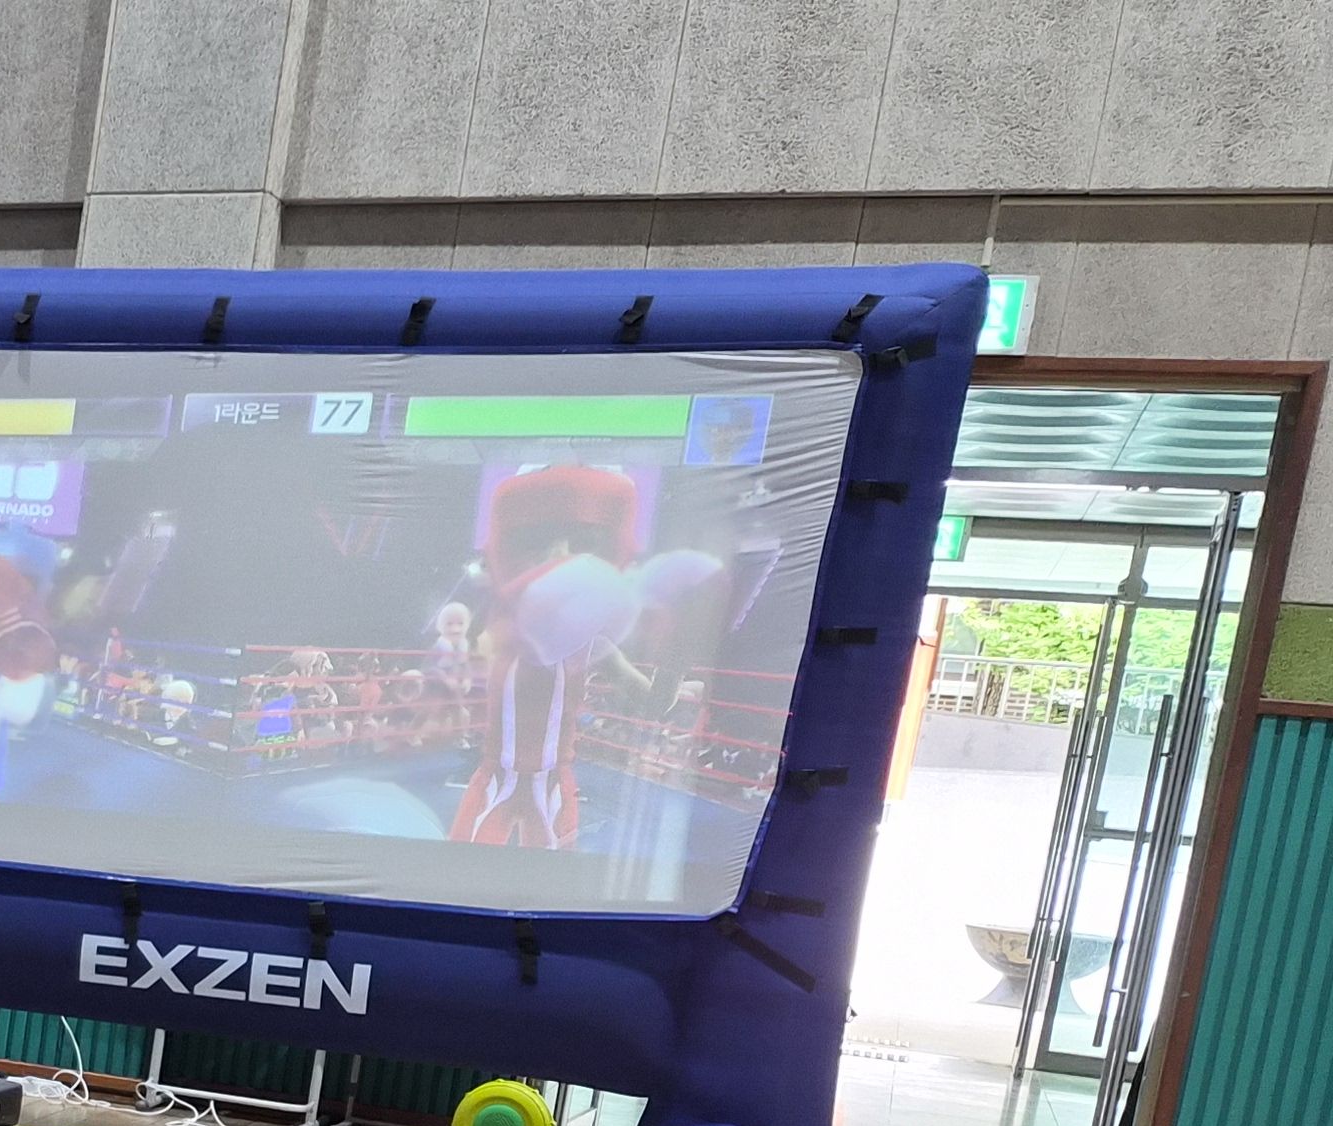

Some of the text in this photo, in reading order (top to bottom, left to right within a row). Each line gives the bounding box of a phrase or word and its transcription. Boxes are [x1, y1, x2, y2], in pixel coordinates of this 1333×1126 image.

[213, 402, 281, 425] 1라운드
[321, 400, 365, 427] 77
[79, 934, 372, 1015] EXZEN
